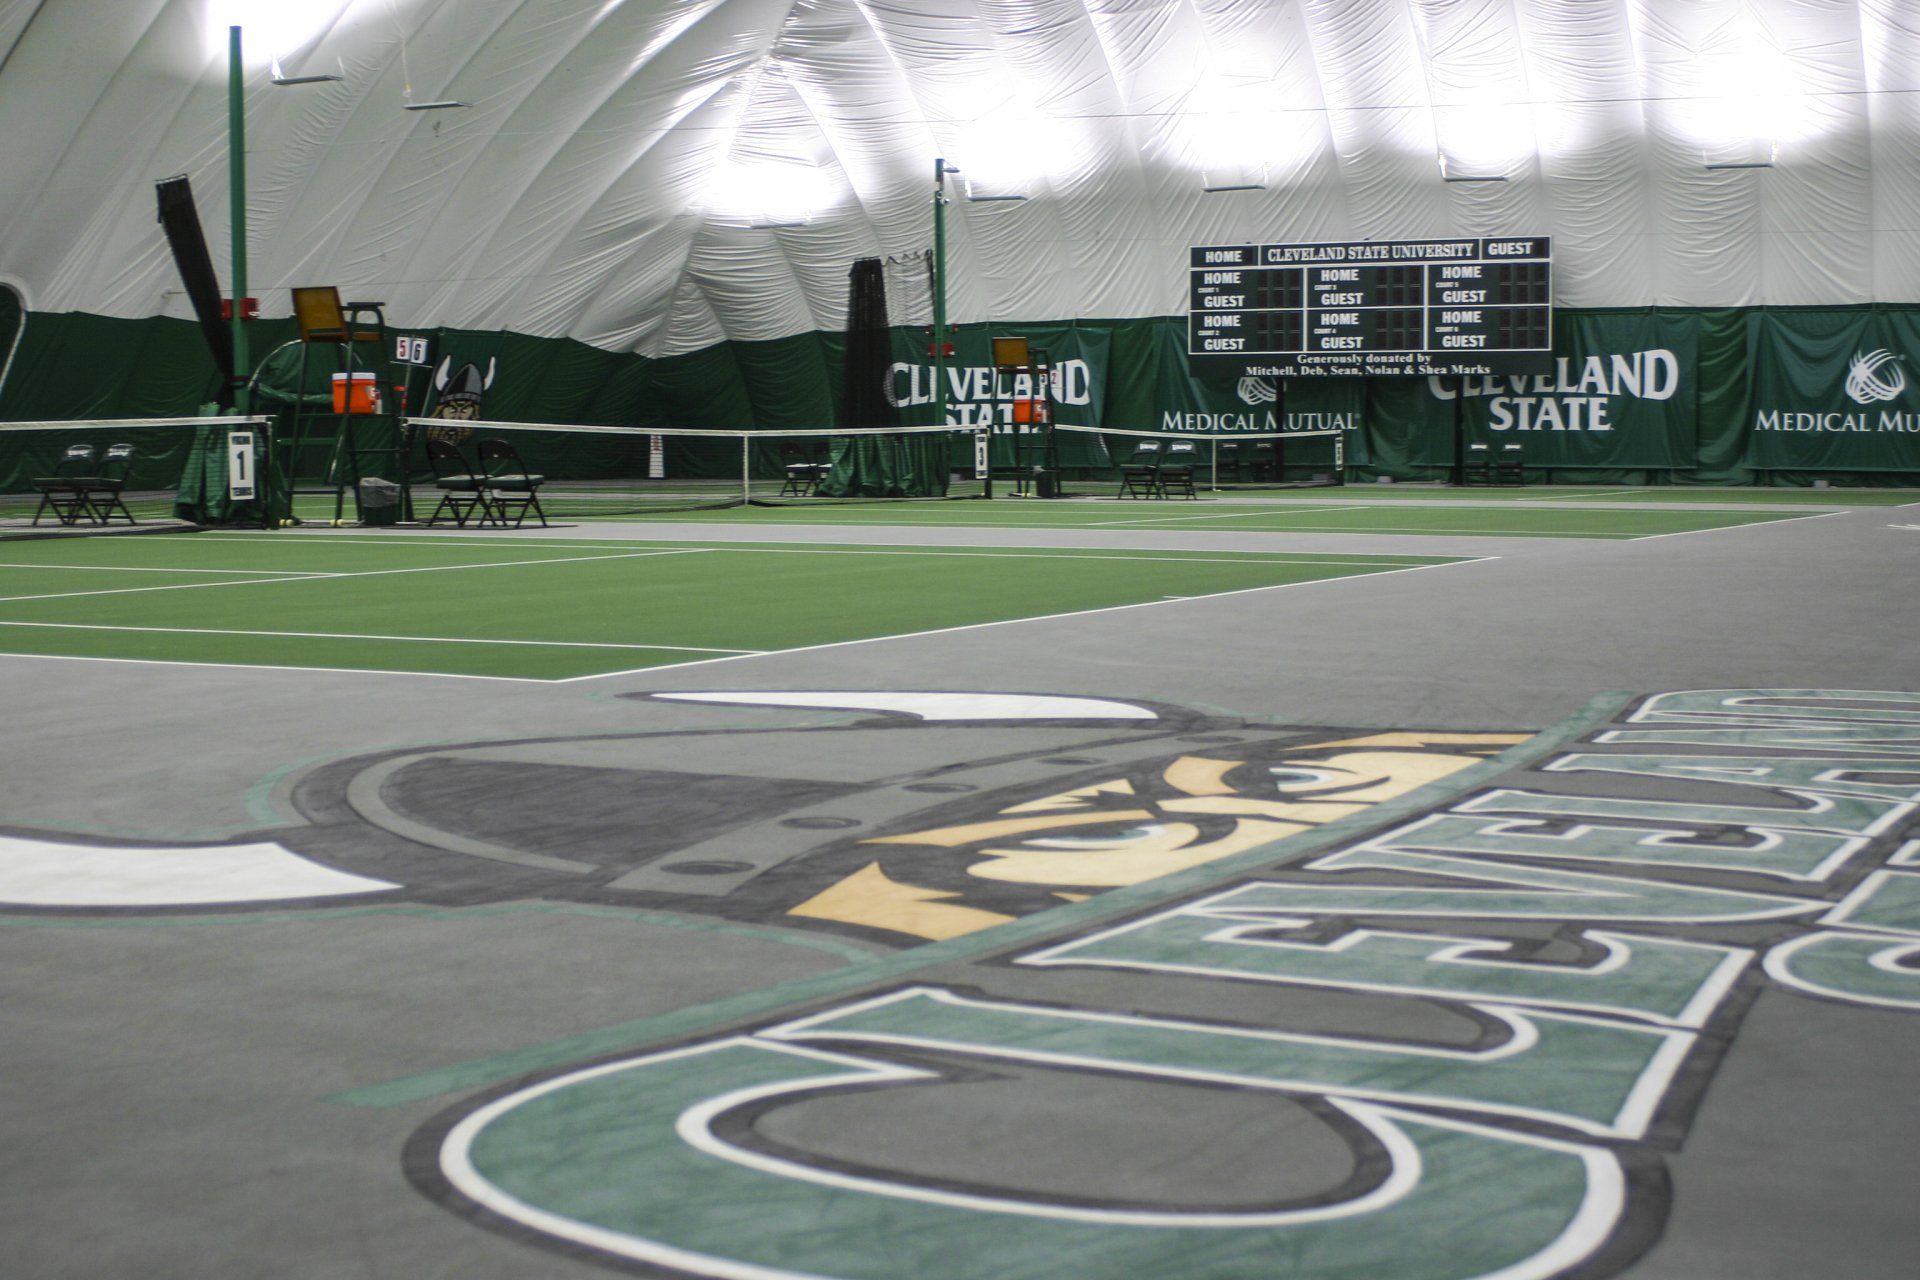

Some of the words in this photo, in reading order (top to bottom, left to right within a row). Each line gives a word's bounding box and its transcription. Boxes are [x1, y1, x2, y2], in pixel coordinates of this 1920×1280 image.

[1267, 247, 1346, 262] CLEVELAND
[1347, 245, 1390, 260] STATE
[1392, 243, 1474, 259] UNIVERSITY
[1487, 242, 1534, 255] GUEST
[1205, 250, 1243, 263] HOME
[1203, 272, 1242, 284] HOME
[1320, 269, 1360, 282] HOME
[1442, 266, 1483, 279] HOME
[1203, 295, 1245, 308] GUEST
[1320, 292, 1364, 305] GUEST
[1442, 290, 1487, 303] GUEST
[1203, 315, 1242, 328] HOME
[1320, 313, 1360, 326] HOME
[1441, 311, 1483, 324] HOME
[1203, 338, 1246, 351] GUEST
[1320, 336, 1364, 349] GUEST
[1441, 335, 1487, 347] GUEST
[399, 340, 406, 357] 5
[414, 343, 421, 360] 6
[1296, 354, 1363, 367] Generously
[1366, 354, 1413, 364] donated
[1417, 353, 1432, 365] by
[1245, 366, 1297, 376] Mitchell,
[1300, 365, 1327, 376] Deb,
[1330, 365, 1363, 376] Sean,
[1366, 365, 1400, 375] Nolan
[1404, 365, 1415, 374] &
[1418, 364, 1447, 375] Shea
[1451, 364, 1491, 374] Marks
[1161, 410, 1259, 431] MEDICAL
[1489, 397, 1612, 431] STATE
[1754, 410, 1871, 432] MEDICAL
[236, 450, 245, 480] 1
